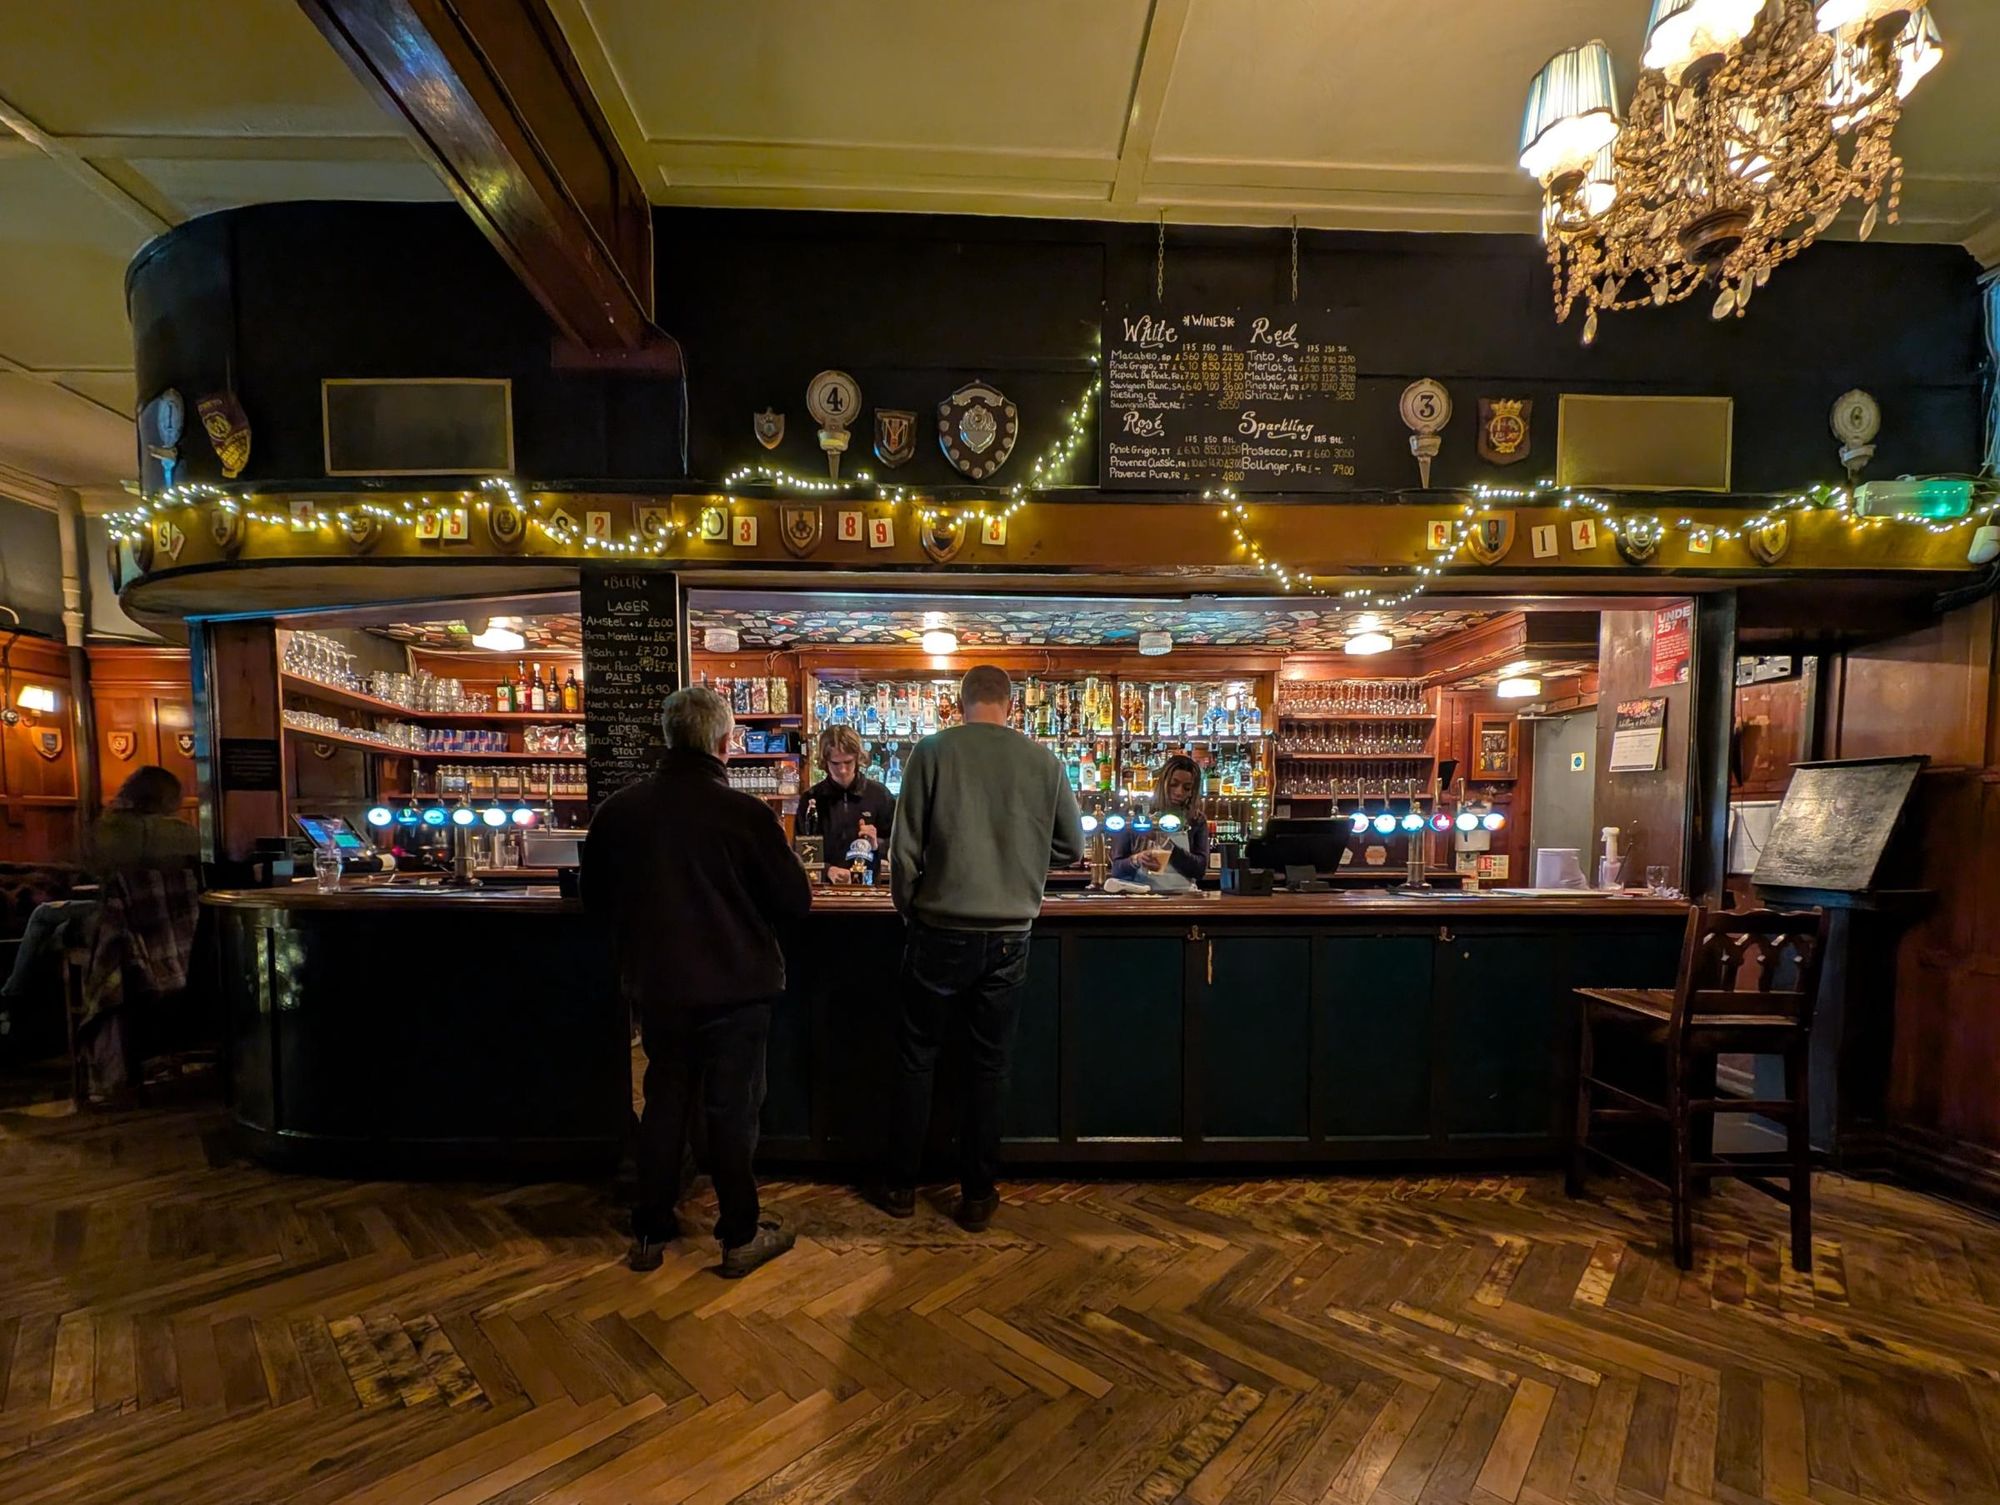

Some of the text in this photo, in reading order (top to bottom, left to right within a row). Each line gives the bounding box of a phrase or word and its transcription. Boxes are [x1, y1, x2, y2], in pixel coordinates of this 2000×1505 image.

[1123, 314, 1178, 343] White
[1250, 317, 1297, 344] Red
[1183, 343, 1197, 351] 175
[826, 387, 843, 411] 4
[1419, 394, 1435, 418] 3
[1123, 411, 1164, 434] Rosé
[1238, 410, 1314, 441] Sparkling
[449, 513, 460, 534] 5
[594, 516, 605, 536] 2
[740, 520, 751, 542] 3
[845, 515, 856, 537] 8
[876, 522, 887, 543] 9
[1579, 525, 1590, 544] 4
[607, 600, 649, 612] LAGER
[1658, 606, 1691, 623] UNDE
[1657, 620, 1677, 635] 25?
[605, 672, 641, 683] PALES
[608, 724, 640, 734] CIDER
[612, 747, 645, 756] STOUT
